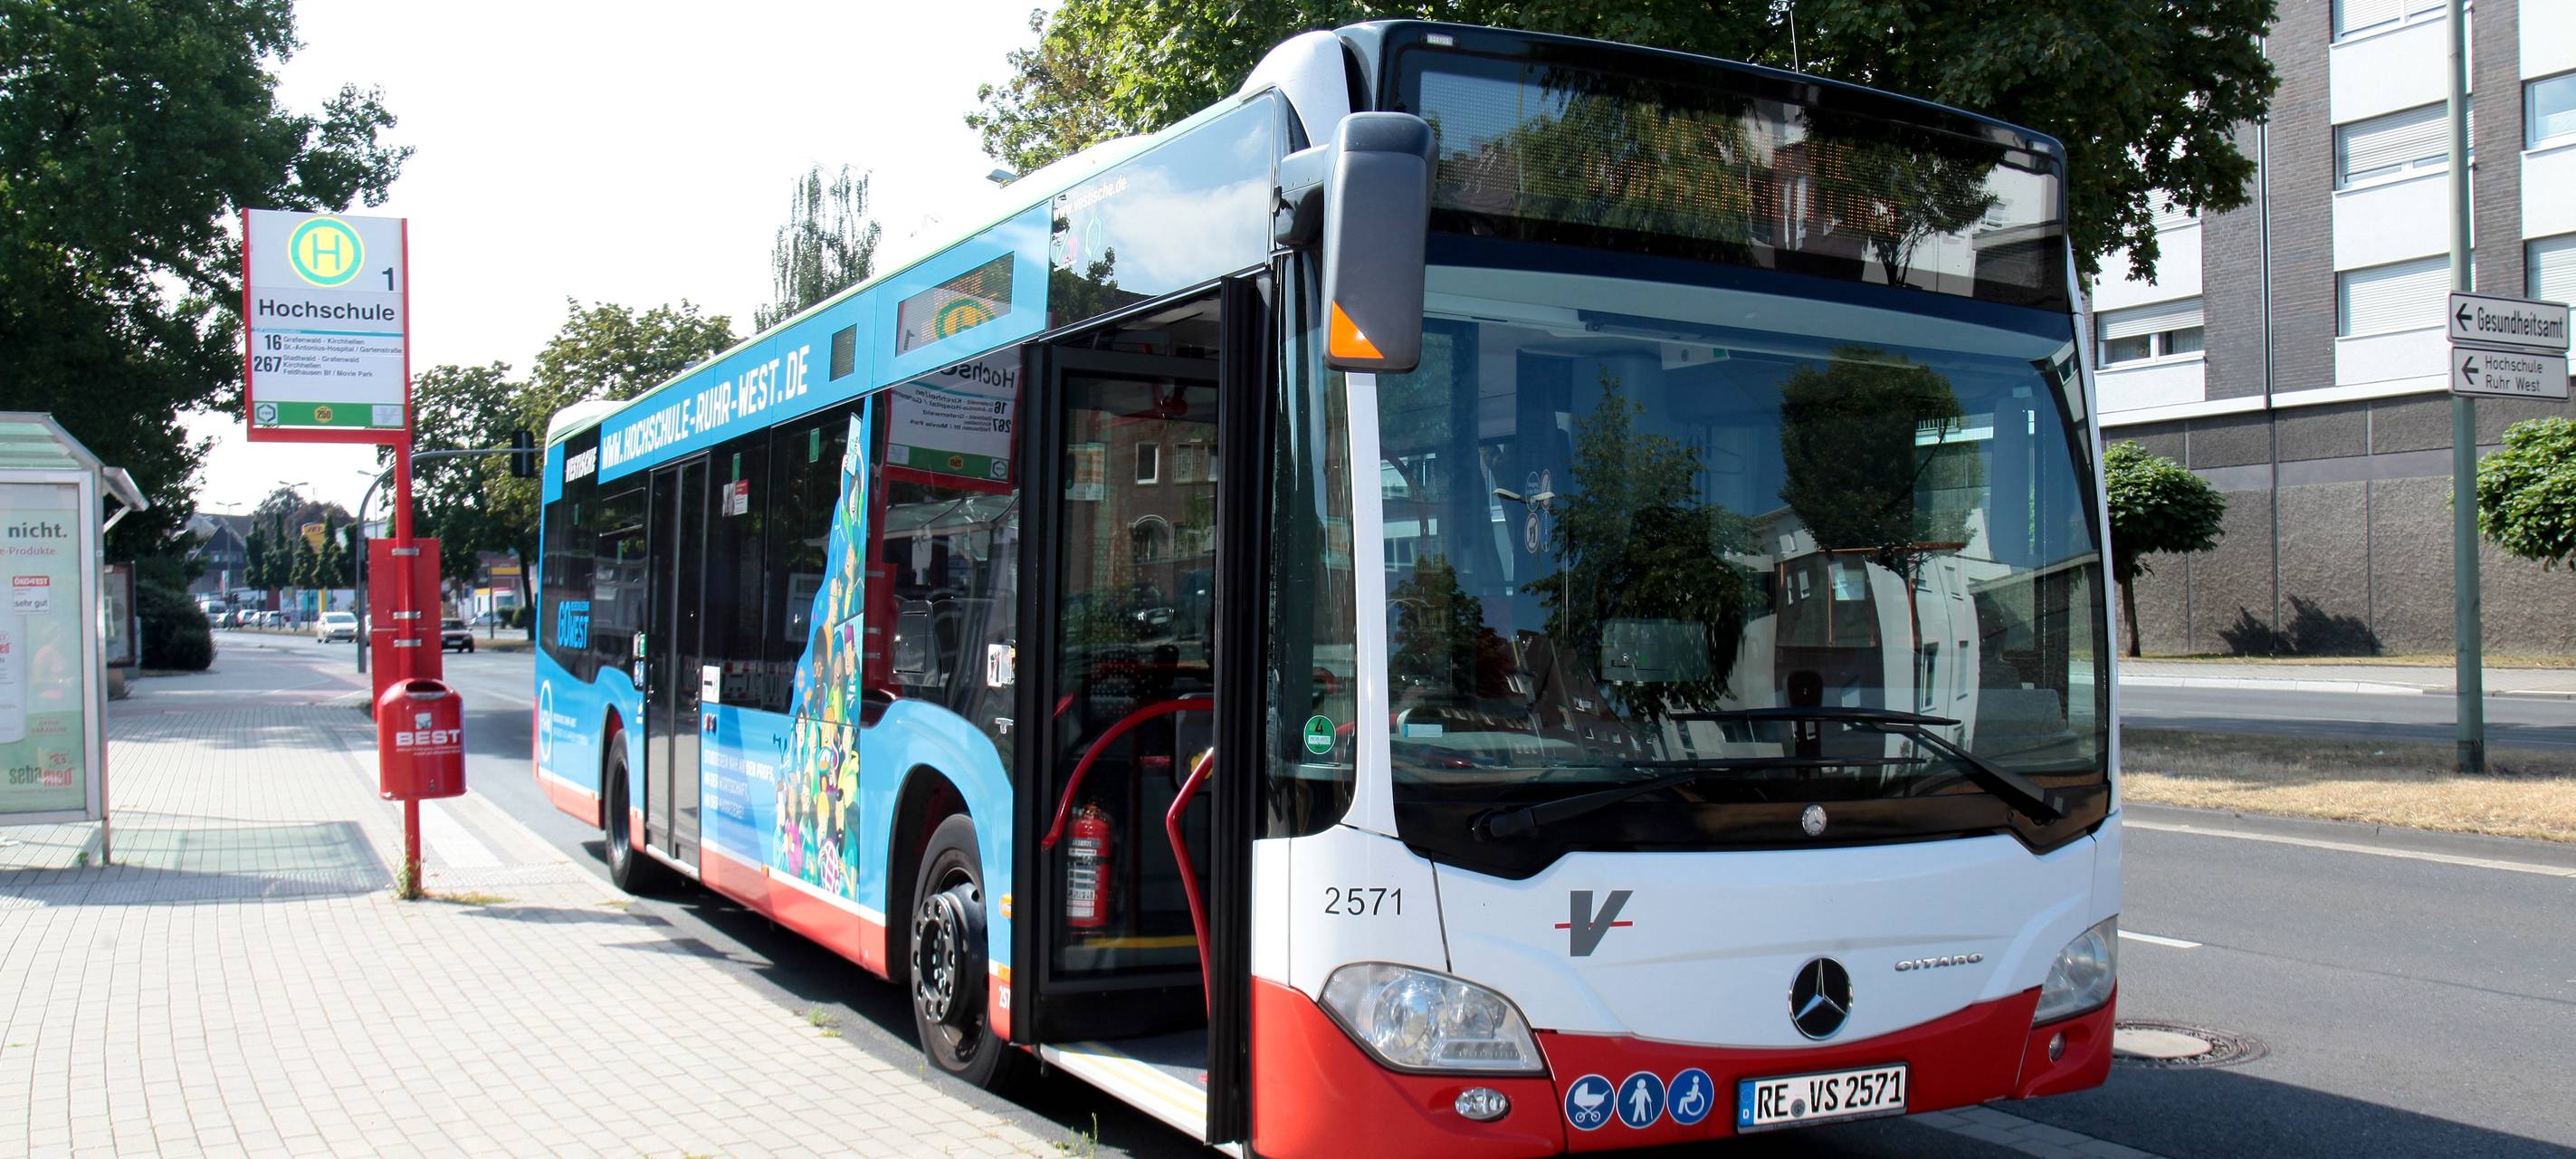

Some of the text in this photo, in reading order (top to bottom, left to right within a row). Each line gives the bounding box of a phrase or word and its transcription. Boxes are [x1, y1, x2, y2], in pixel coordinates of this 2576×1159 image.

[1053, 174, 1129, 221] www.vestische.de
[1582, 153, 1664, 203] WIR
[1675, 167, 1816, 224] FAHREN
[312, 233, 340, 271] H
[382, 267, 395, 291] 1
[259, 299, 395, 321] Hochschule
[2477, 306, 2563, 339] Gesundheitsamt
[265, 334, 281, 350] 16
[283, 336, 321, 344] Grafenwald
[254, 355, 281, 372] 267
[321, 355, 359, 363] Grafenwald
[2485, 355, 2543, 374] Hochschule
[283, 368, 322, 376] Feldhausen
[2485, 374, 2541, 392] Ruhr West
[602, 344, 810, 470] WWW.HOCHSCHULE-RUHR-WEST.DE
[8, 522, 68, 538] nicht.
[14, 599, 48, 609] sehr gut
[558, 601, 590, 649] GO WEST
[1314, 718, 1324, 735] 4
[396, 729, 461, 746] BEST
[1324, 886, 1402, 915] 2571
[1894, 953, 1984, 972] CITARO
[1757, 1071, 1902, 1119] RE VS 2571
[1742, 1108, 1750, 1119] D
